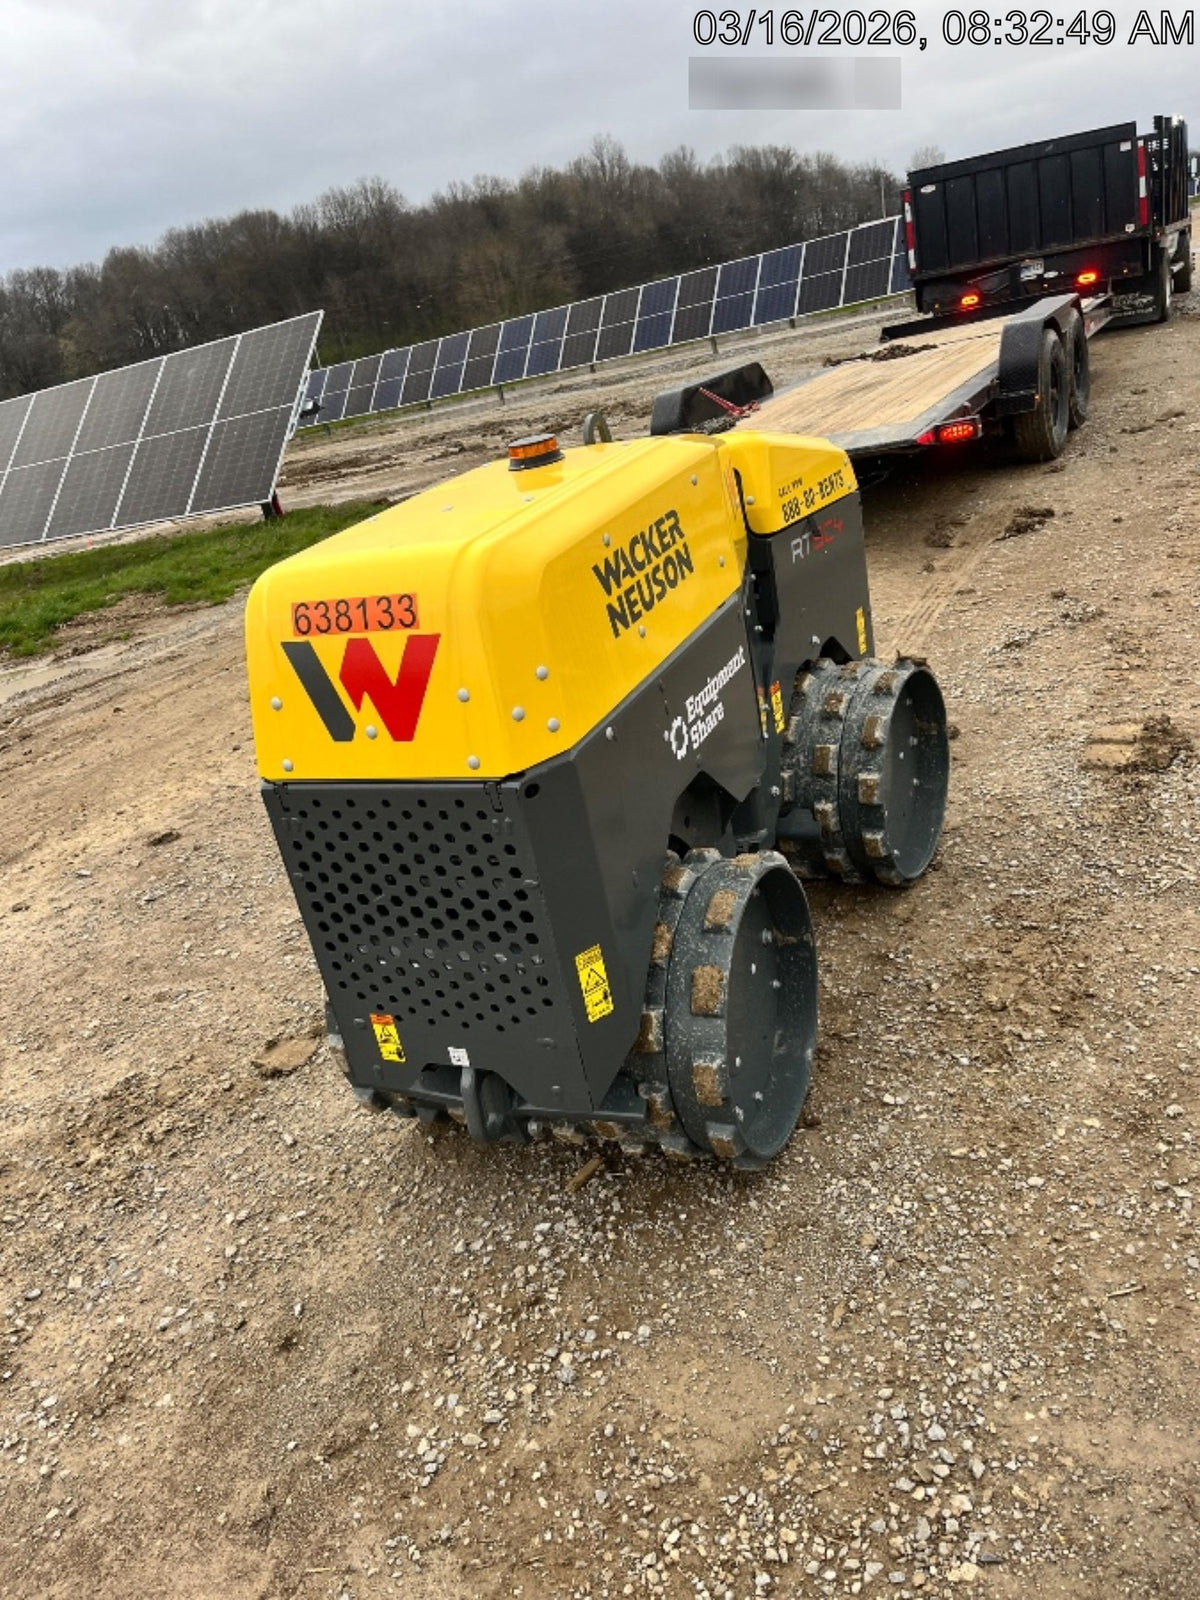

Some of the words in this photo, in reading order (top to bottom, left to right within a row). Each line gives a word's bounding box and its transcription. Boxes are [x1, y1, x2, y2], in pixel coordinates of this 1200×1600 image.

[592, 509, 685, 597] WACKER
[606, 542, 694, 639] NEUSON
[294, 593, 417, 635] 638133
[685, 645, 746, 723] Equipment
[690, 702, 725, 750] Share
